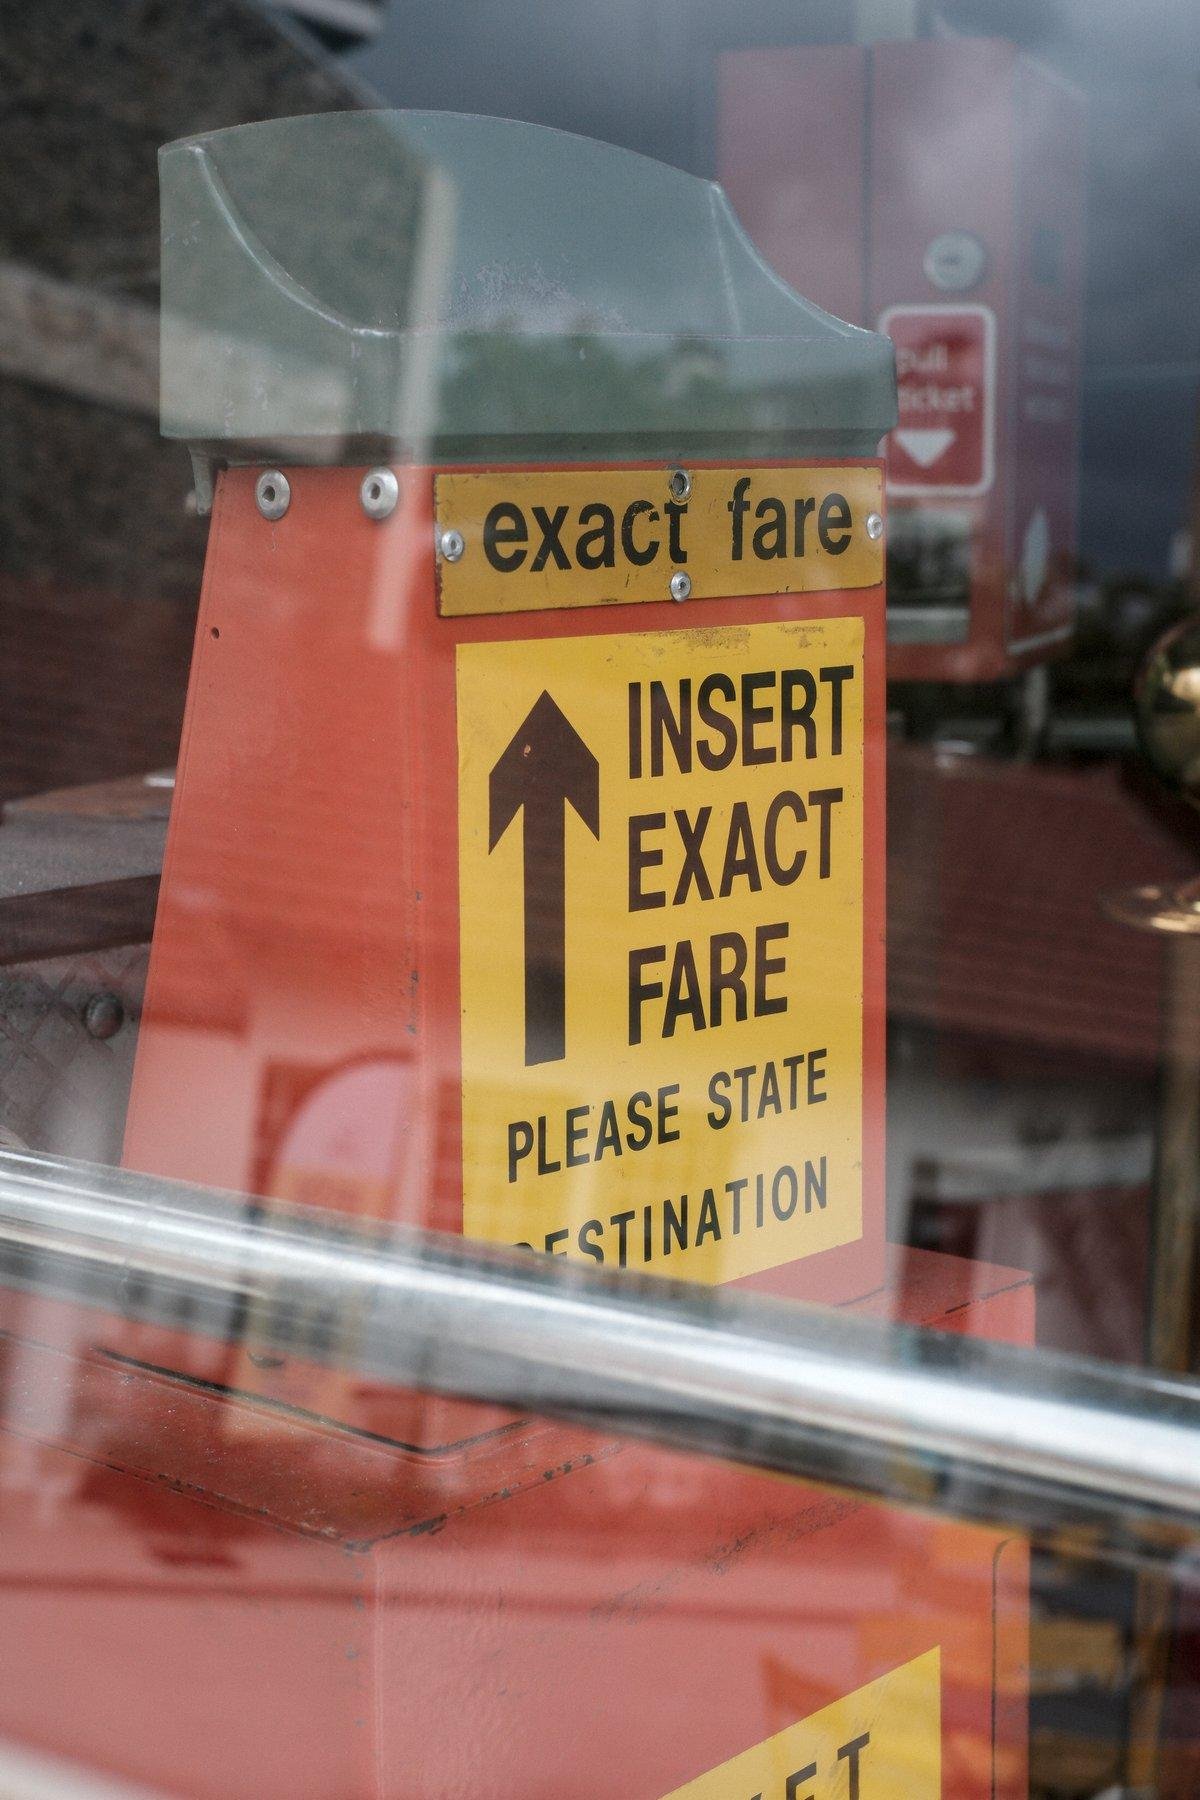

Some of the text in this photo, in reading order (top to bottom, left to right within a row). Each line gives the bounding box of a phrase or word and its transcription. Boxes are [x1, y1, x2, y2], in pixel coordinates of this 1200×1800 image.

[483, 477, 853, 573] exact fare
[628, 665, 854, 779] INSERT
[628, 788, 843, 912] EXACT
[628, 922, 790, 1046] FARE
[508, 1048, 828, 1183] PLEASE STATE
[512, 1156, 828, 1268] STINATION
